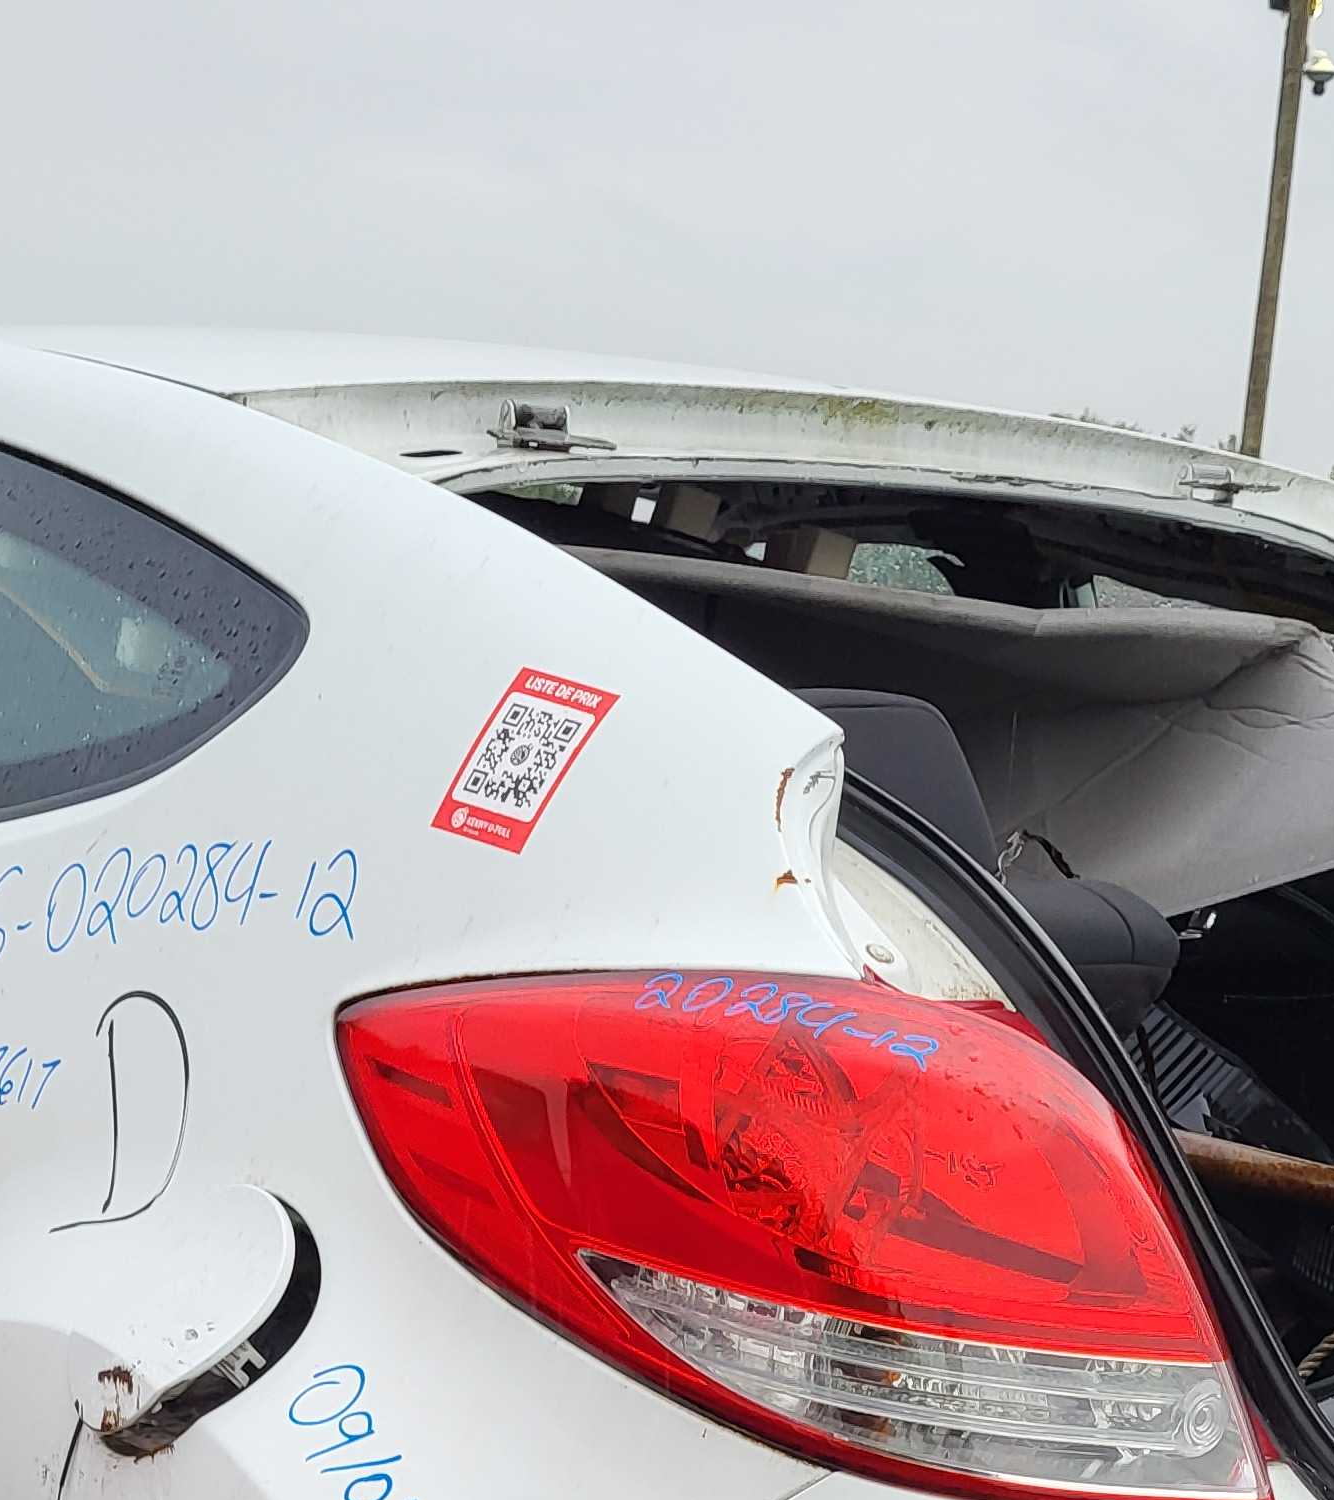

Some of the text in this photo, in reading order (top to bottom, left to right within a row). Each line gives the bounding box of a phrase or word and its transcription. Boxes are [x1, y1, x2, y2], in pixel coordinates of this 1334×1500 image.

[525, 675, 603, 709] LISTE DE PRIX
[634, 972, 939, 1072] 20284-12
